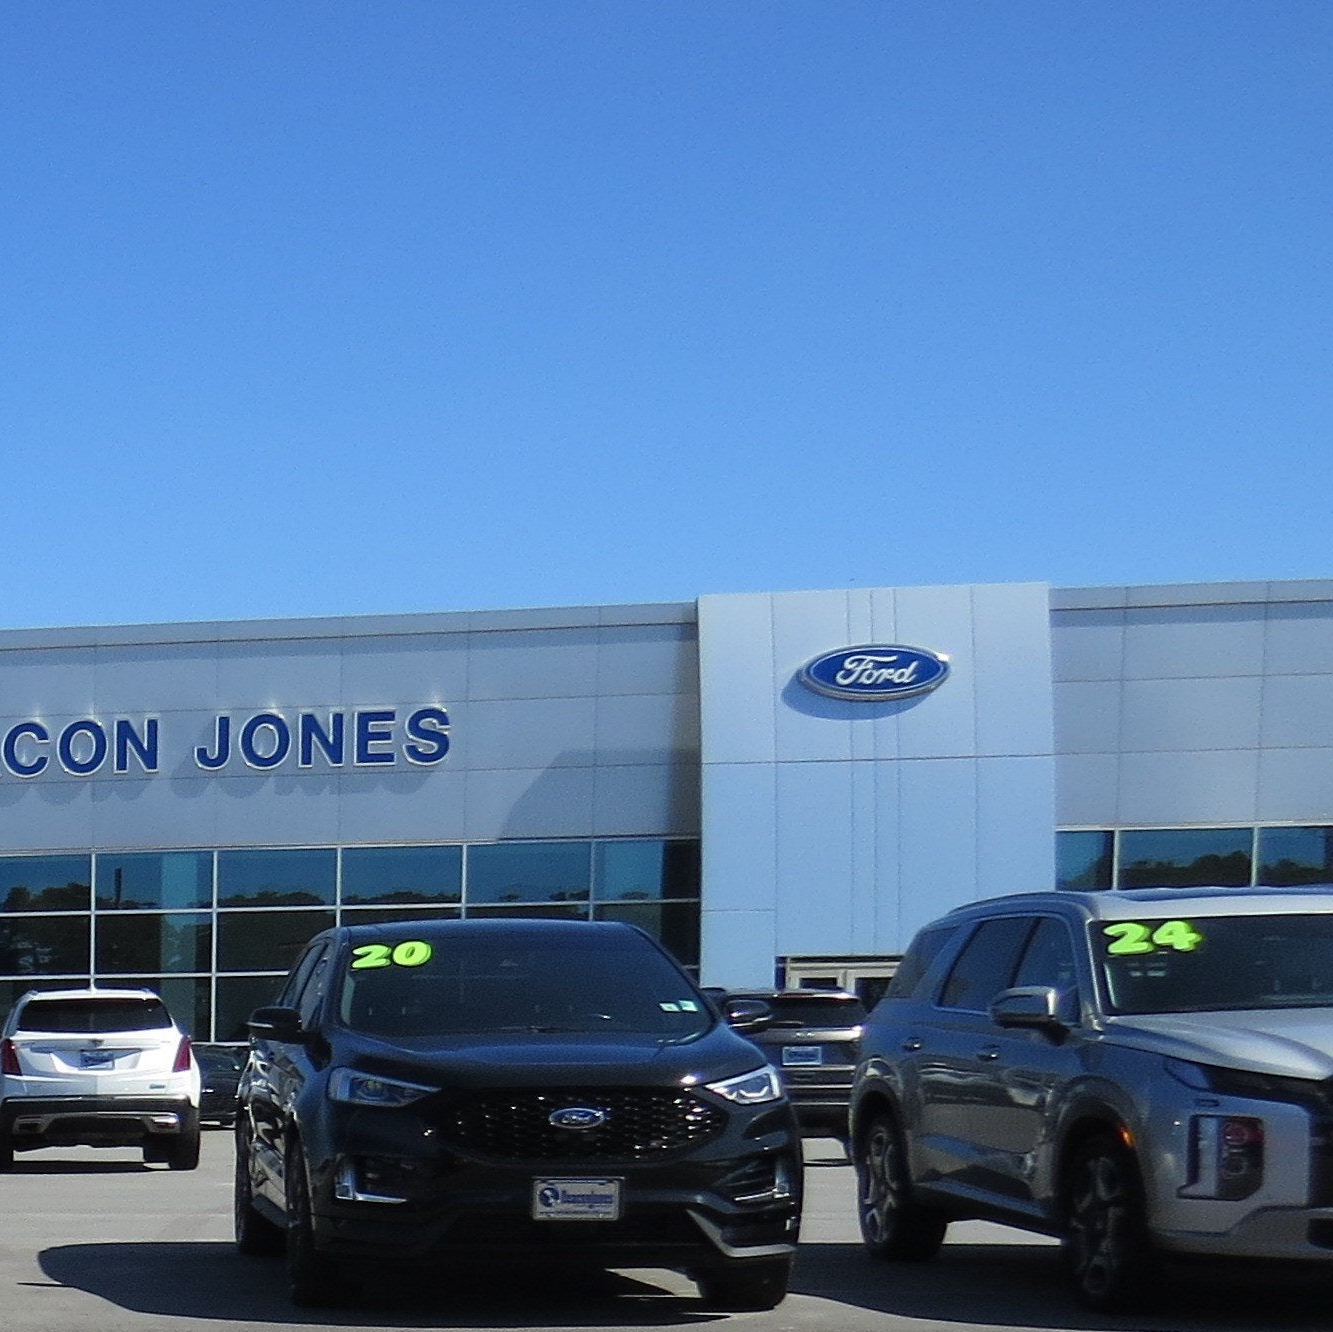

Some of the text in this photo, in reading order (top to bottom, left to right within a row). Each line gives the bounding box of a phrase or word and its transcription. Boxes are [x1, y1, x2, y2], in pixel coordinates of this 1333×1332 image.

[835, 654, 920, 686] Ford
[194, 706, 452, 771] JONES
[1102, 920, 1203, 955] 24
[351, 940, 433, 969] 20
